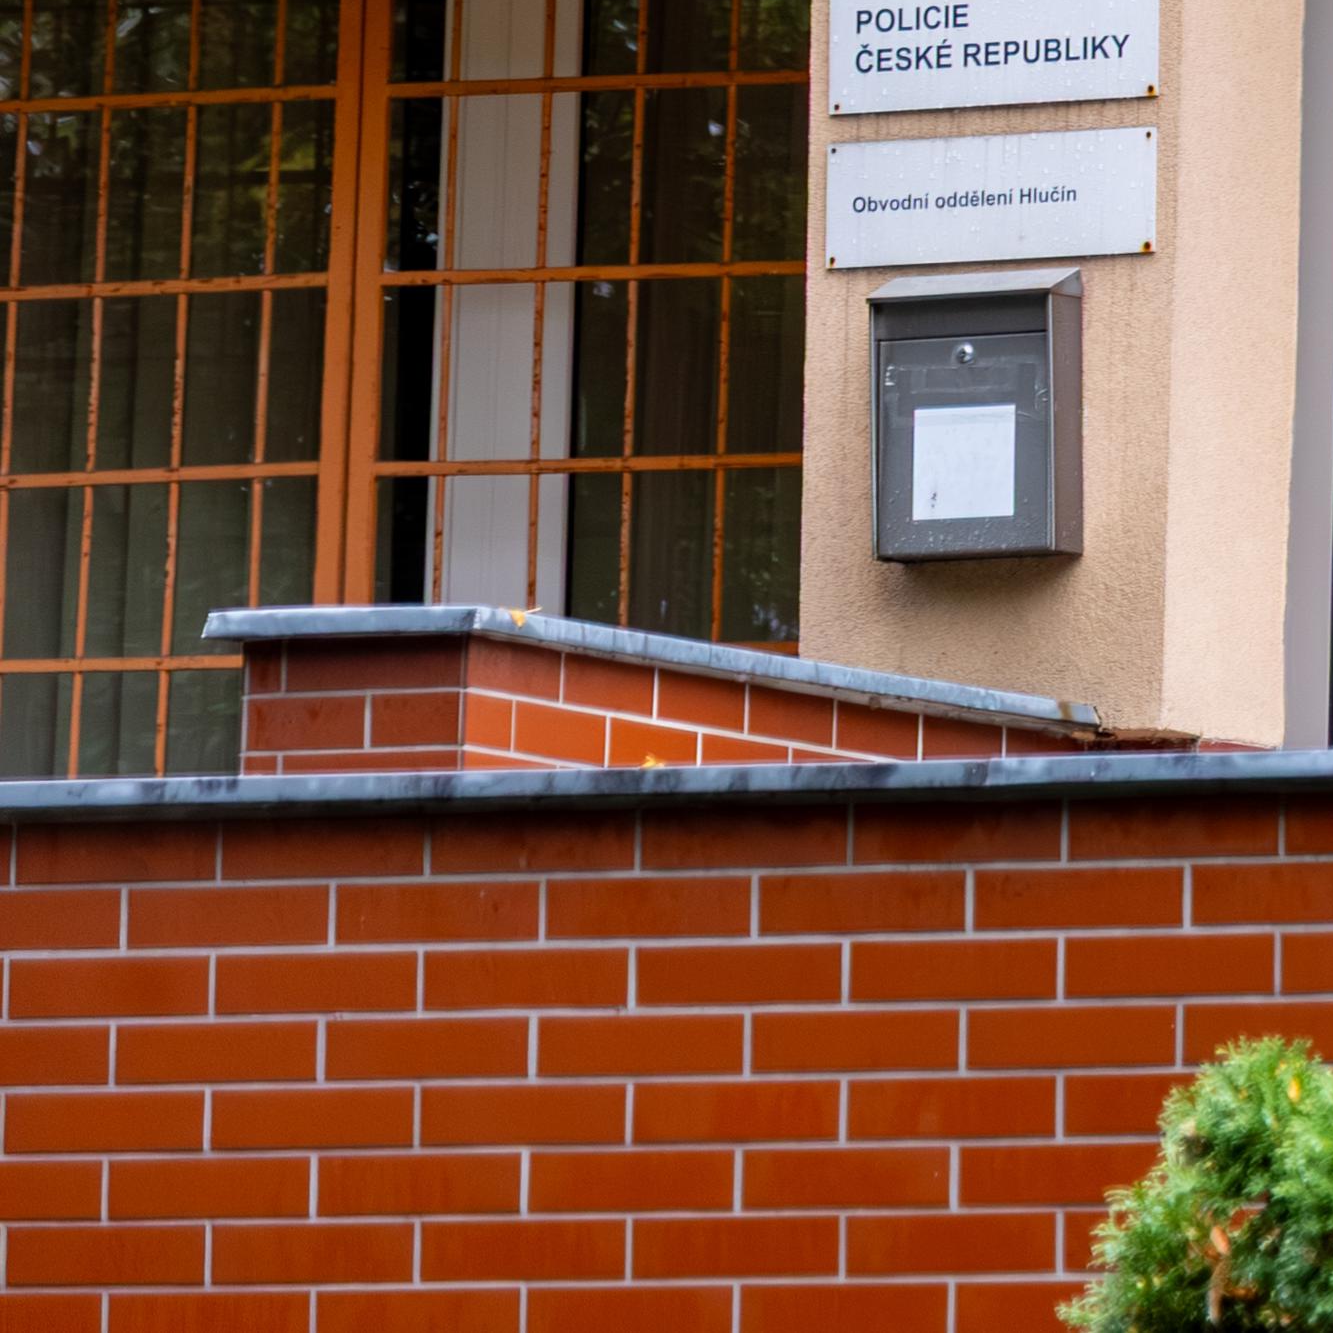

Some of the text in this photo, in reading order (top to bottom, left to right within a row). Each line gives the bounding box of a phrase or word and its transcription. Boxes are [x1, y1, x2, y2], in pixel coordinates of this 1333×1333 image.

[855, 4, 970, 34] POLICIE
[855, 34, 1130, 73] ČESKÉ REPUBLIKY
[852, 185, 1078, 214] Obvodní oddělení Hlučín
